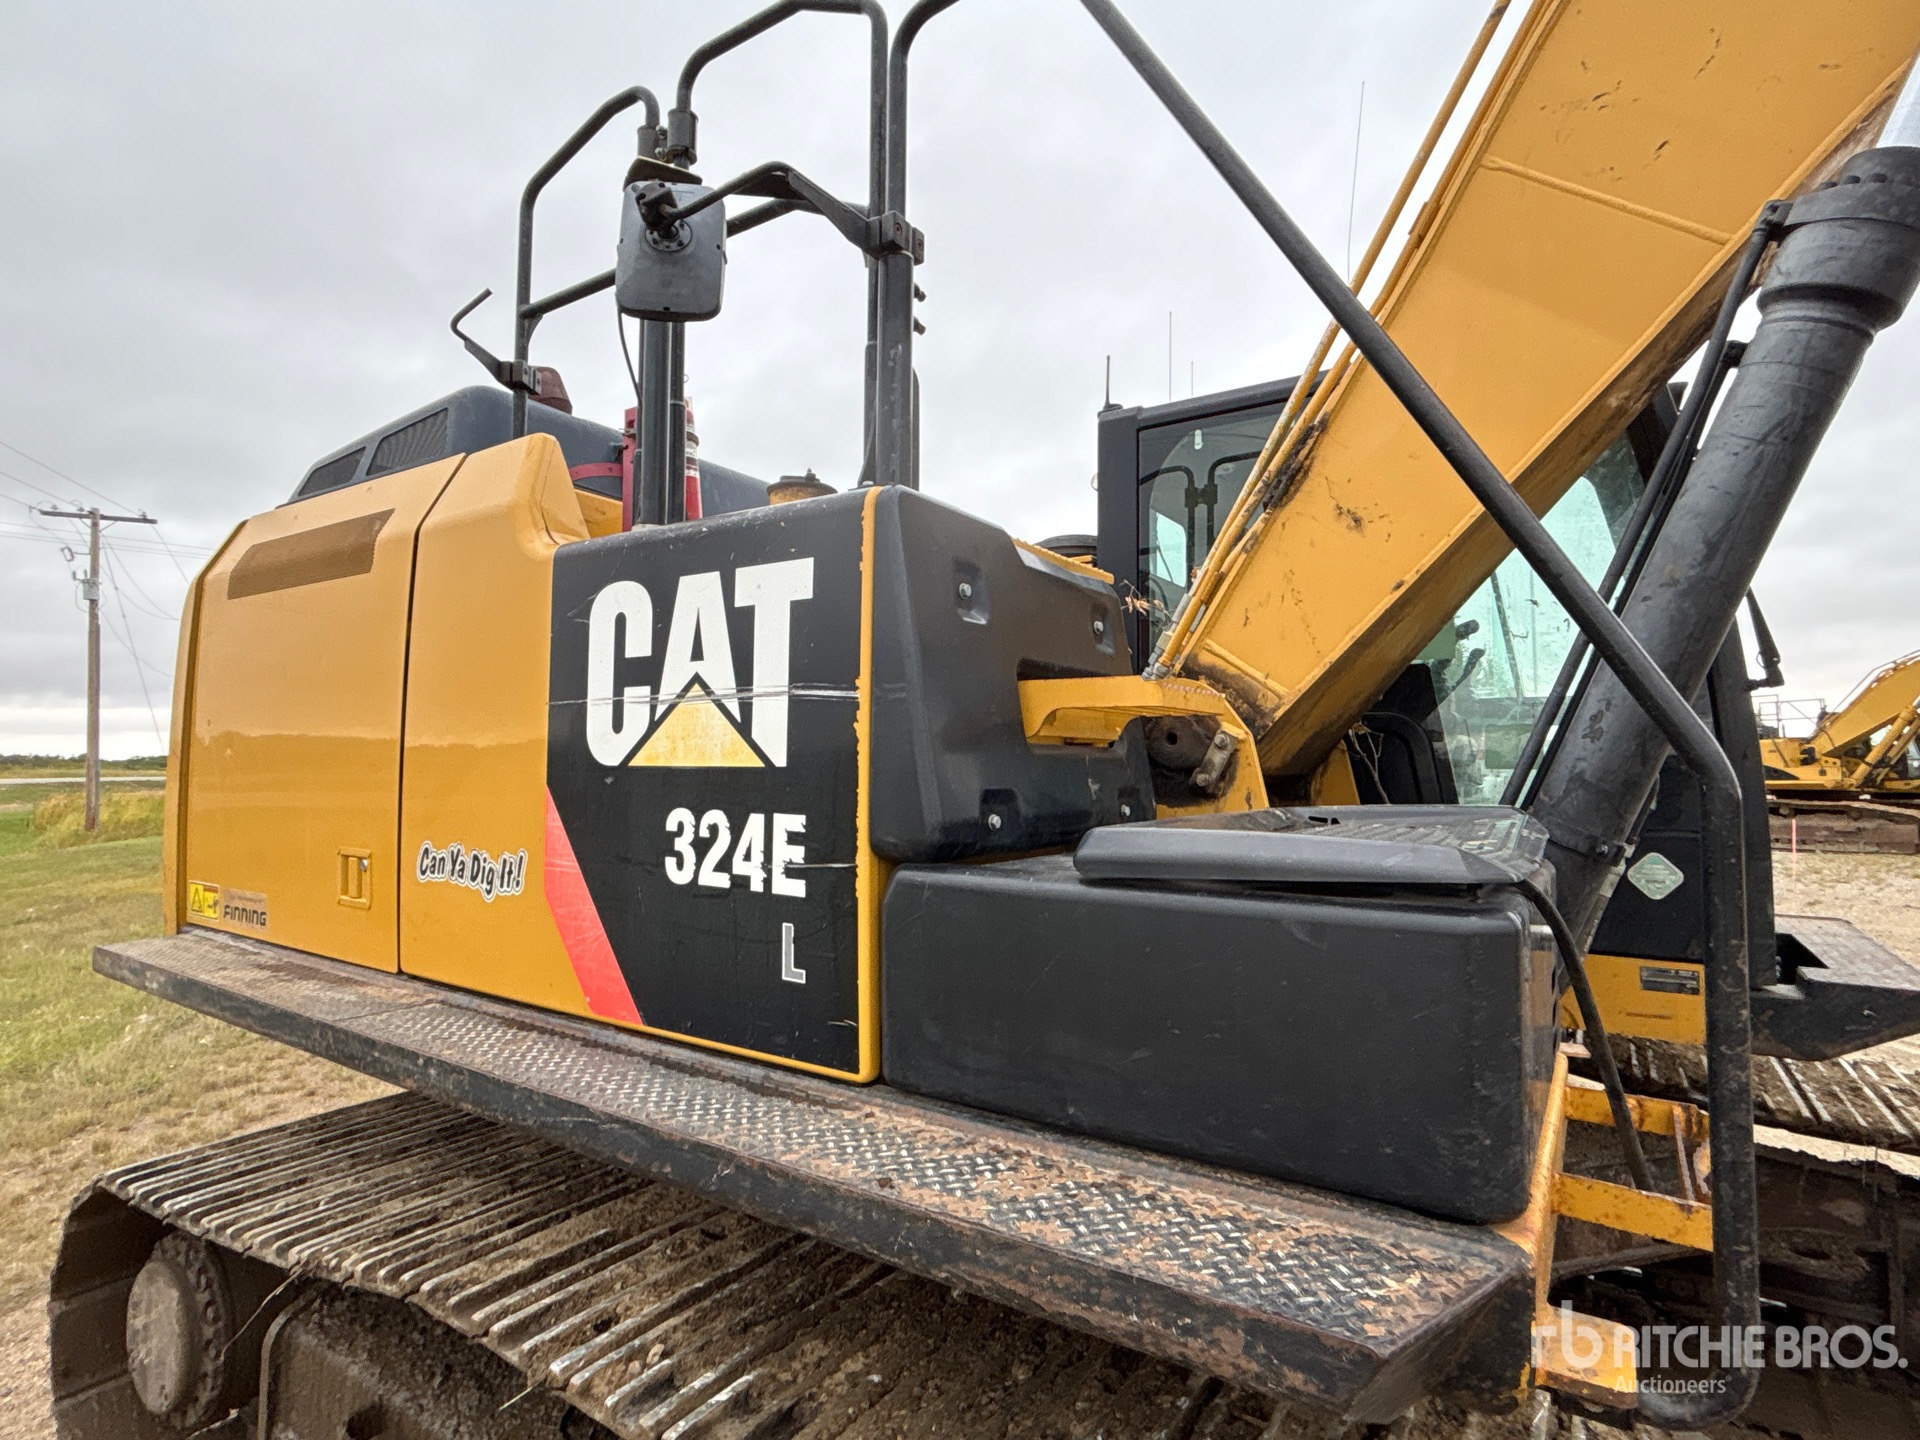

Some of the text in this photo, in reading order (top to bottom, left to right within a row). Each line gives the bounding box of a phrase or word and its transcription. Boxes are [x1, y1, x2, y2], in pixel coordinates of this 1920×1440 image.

[586, 557, 814, 768] CAT
[419, 846, 524, 896] Can Ya Dig It!
[665, 807, 806, 898] 324E
[223, 904, 267, 927] FINNING
[782, 922, 806, 984] L
